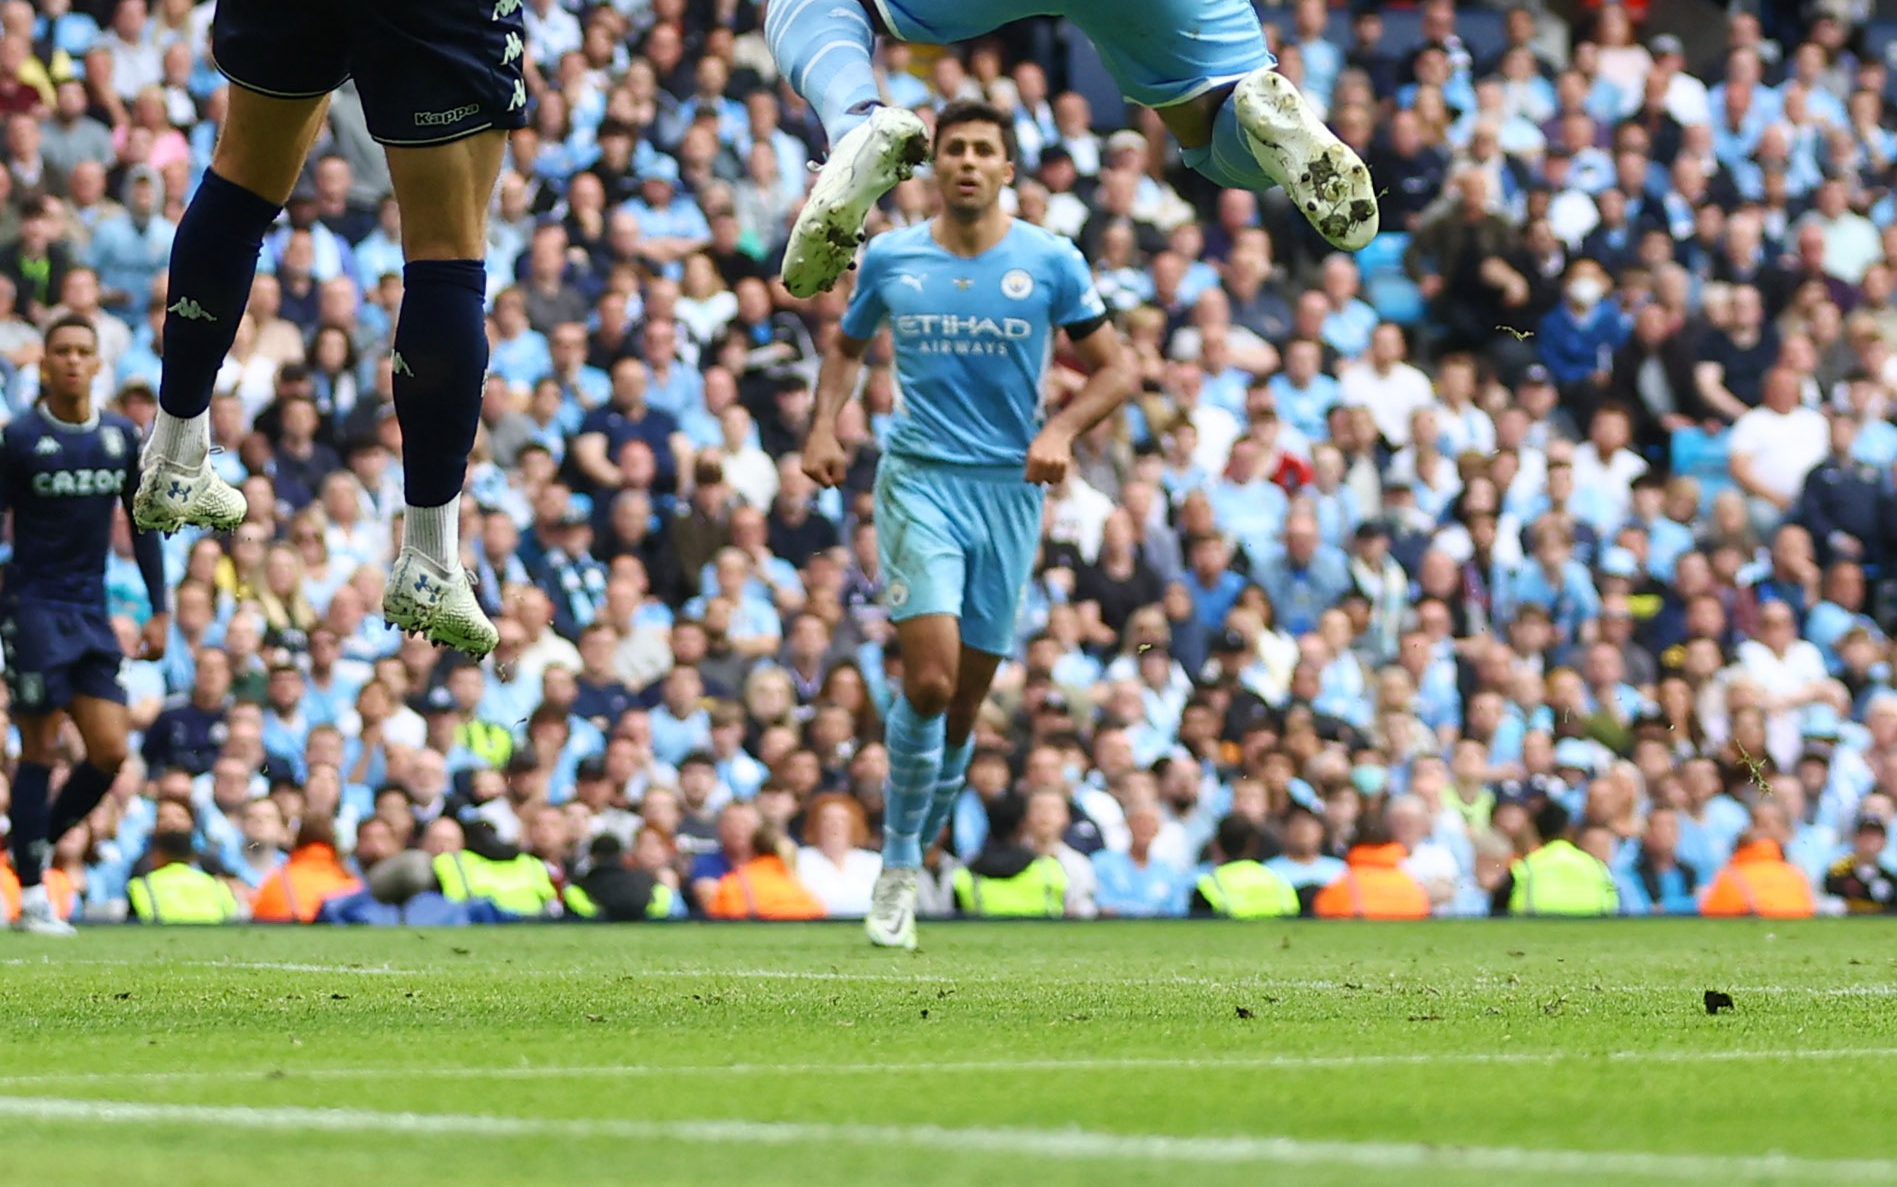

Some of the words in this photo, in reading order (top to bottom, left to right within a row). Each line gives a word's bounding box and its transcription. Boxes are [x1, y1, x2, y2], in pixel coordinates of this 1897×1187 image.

[415, 103, 480, 126] Kappa
[897, 314, 1033, 340] ETIHAD
[919, 340, 1009, 355] AIRWAYS
